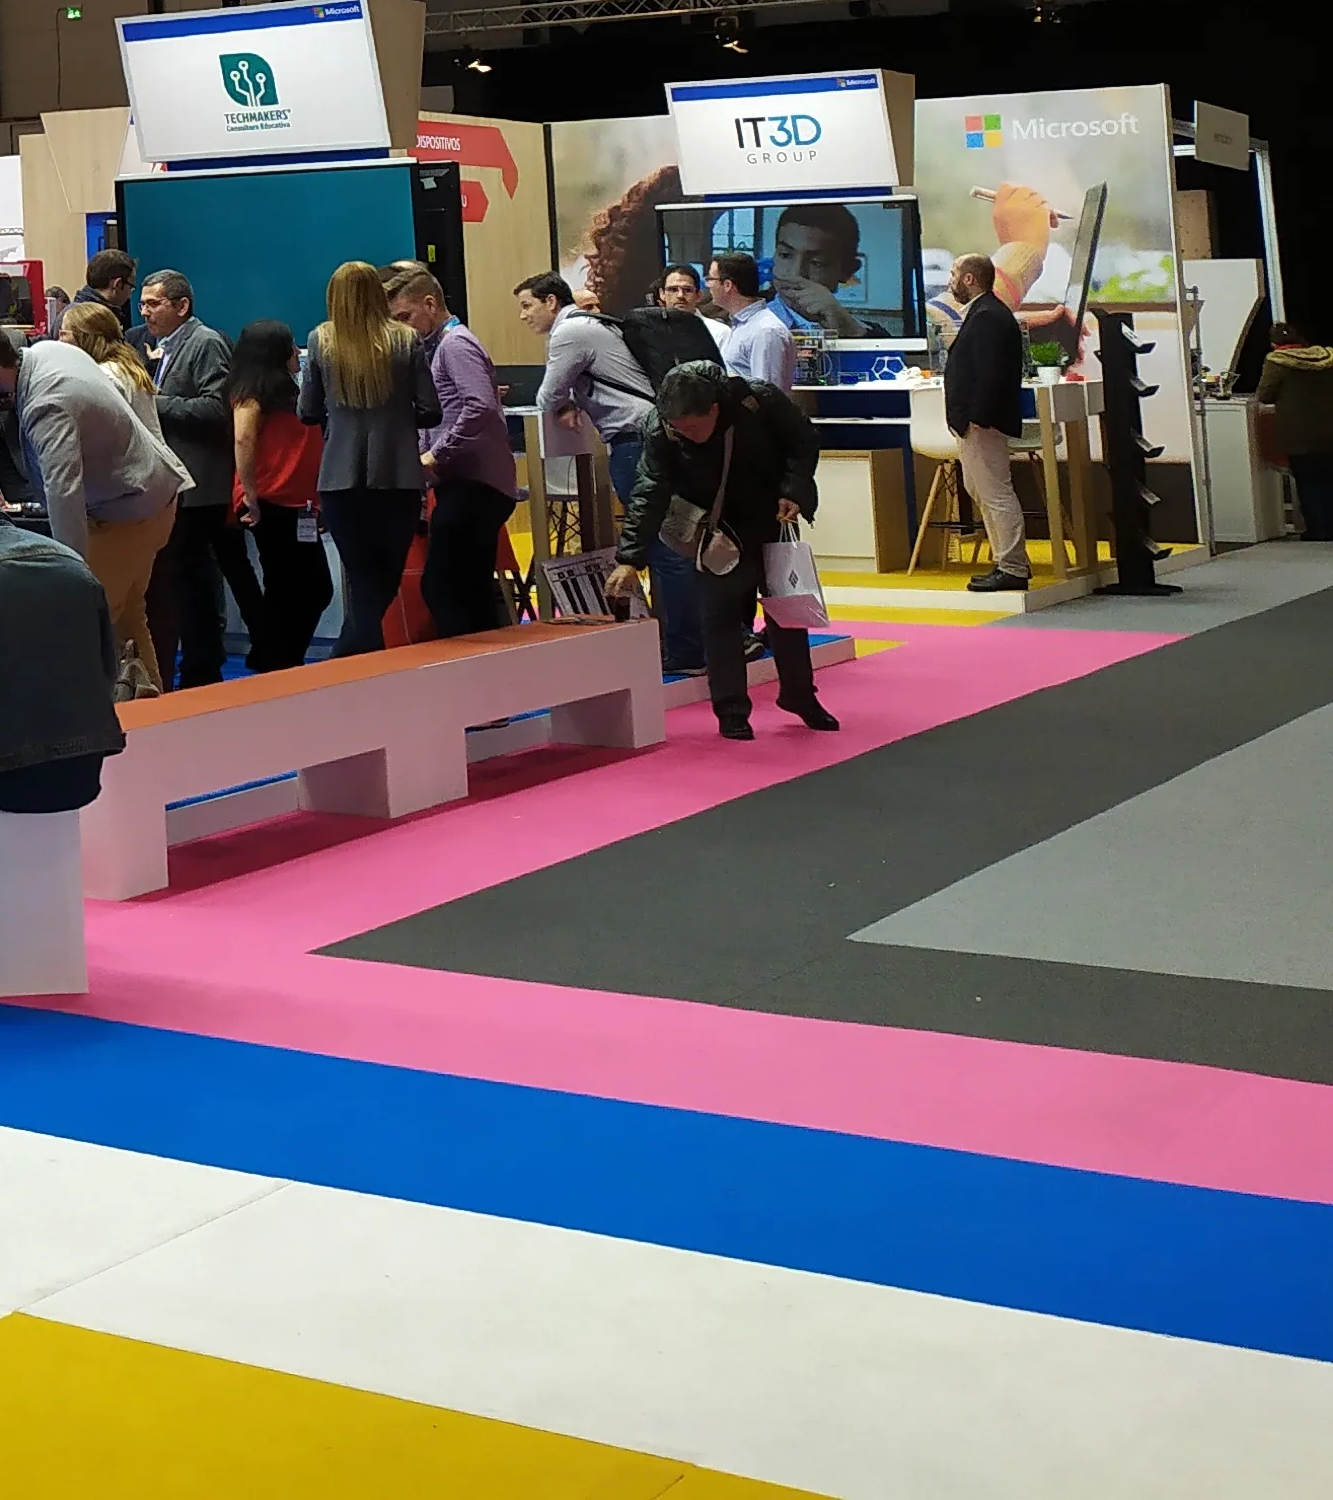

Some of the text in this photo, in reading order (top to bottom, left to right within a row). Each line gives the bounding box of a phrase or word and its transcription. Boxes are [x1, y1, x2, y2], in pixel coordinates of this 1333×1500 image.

[325, 5, 360, 15] Microsoft
[735, 114, 822, 148] IT3D
[1012, 112, 1139, 140] Microsoft
[746, 150, 817, 164] GROUP
